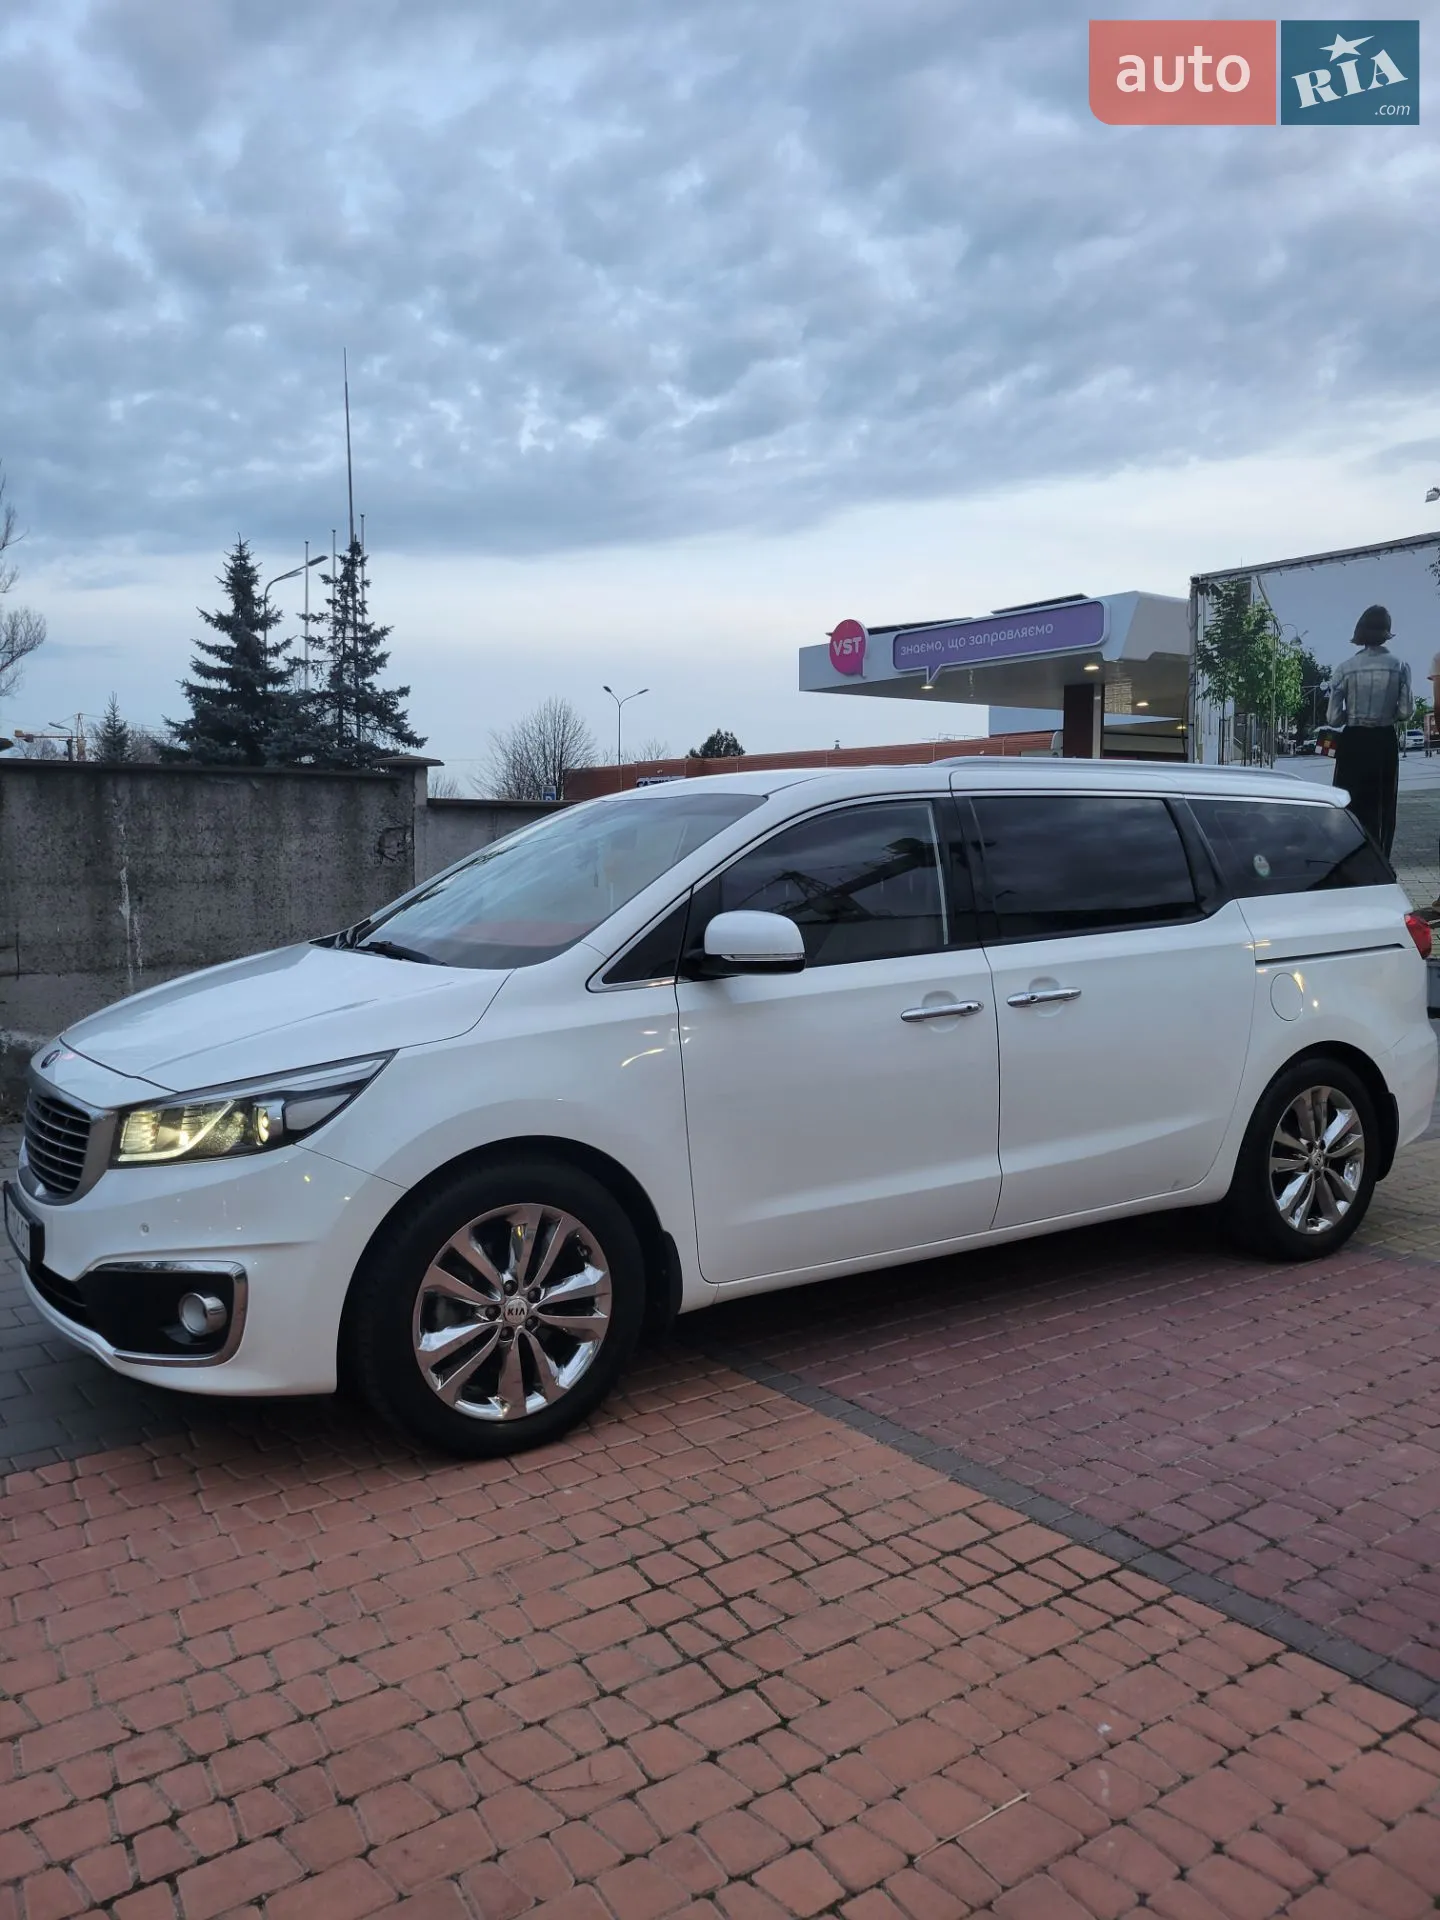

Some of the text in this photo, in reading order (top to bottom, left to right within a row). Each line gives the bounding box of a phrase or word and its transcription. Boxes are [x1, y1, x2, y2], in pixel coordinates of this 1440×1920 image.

[833, 637, 862, 656] VST
[900, 640, 945, 656] знаємо,
[947, 636, 966, 651] що
[507, 1308, 525, 1316] KIA
